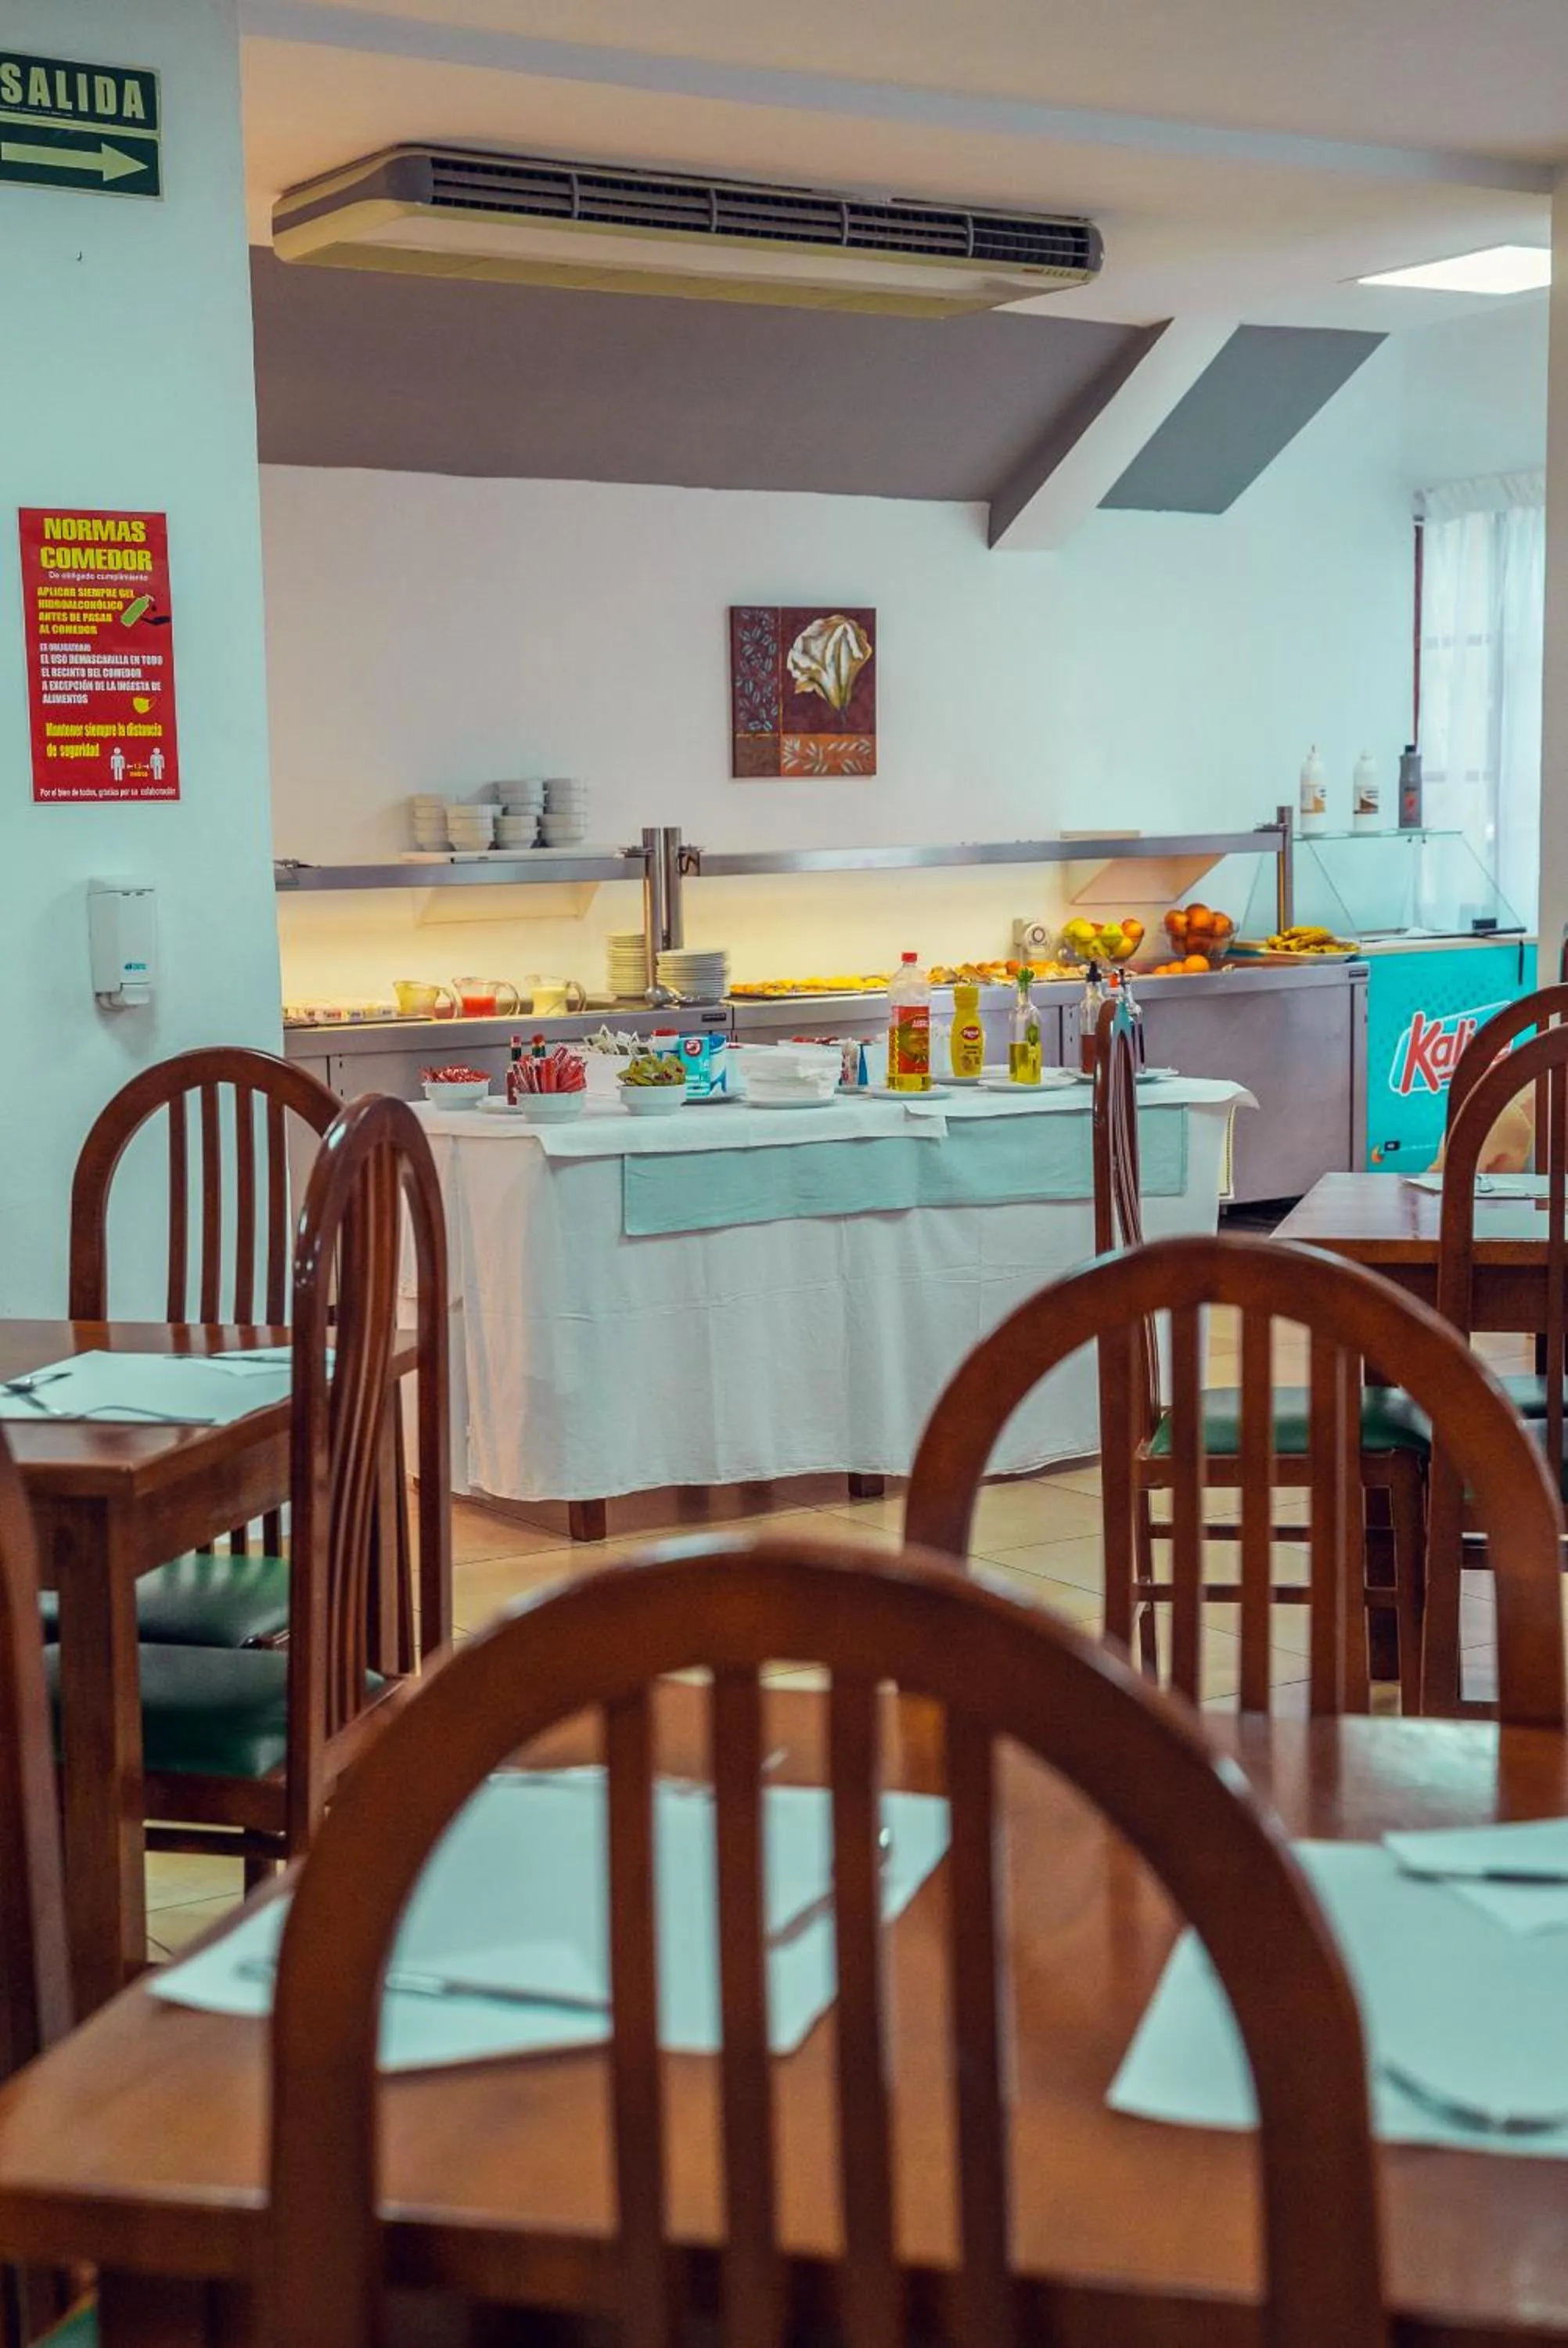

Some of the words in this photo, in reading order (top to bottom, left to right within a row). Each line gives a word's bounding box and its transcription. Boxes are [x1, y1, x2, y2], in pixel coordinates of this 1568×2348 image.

[0, 63, 146, 119] SALIDA
[44, 517, 146, 542] NORMAS
[40, 546, 153, 571] COMEDOR
[37, 586, 76, 597] APLICAR
[77, 587, 117, 598] SIEMPRE
[118, 589, 135, 598] GEL
[38, 599, 124, 611] HIDROALCOHÓLICO
[38, 611, 68, 622] ANTES
[69, 612, 81, 622] DE
[82, 613, 113, 623] PASAR
[39, 624, 50, 635] AL
[51, 625, 98, 636] COMEDOR
[40, 654, 49, 664] EL
[49, 654, 68, 664] USO
[130, 655, 140, 664] EN
[141, 655, 164, 666] TODO
[41, 667, 51, 678] EL
[51, 667, 86, 678] RECINTO
[87, 668, 102, 679] DEL
[102, 668, 142, 679] COMEDOR
[41, 680, 49, 691] A
[49, 679, 94, 692] EXCEPCIÓN
[95, 680, 106, 692] DE
[106, 681, 117, 692] LA
[117, 681, 151, 692] INGESTA
[151, 681, 162, 692] DE
[41, 693, 89, 704] ALIMENTOS
[46, 743, 57, 758] de
[59, 743, 100, 759] seguridad
